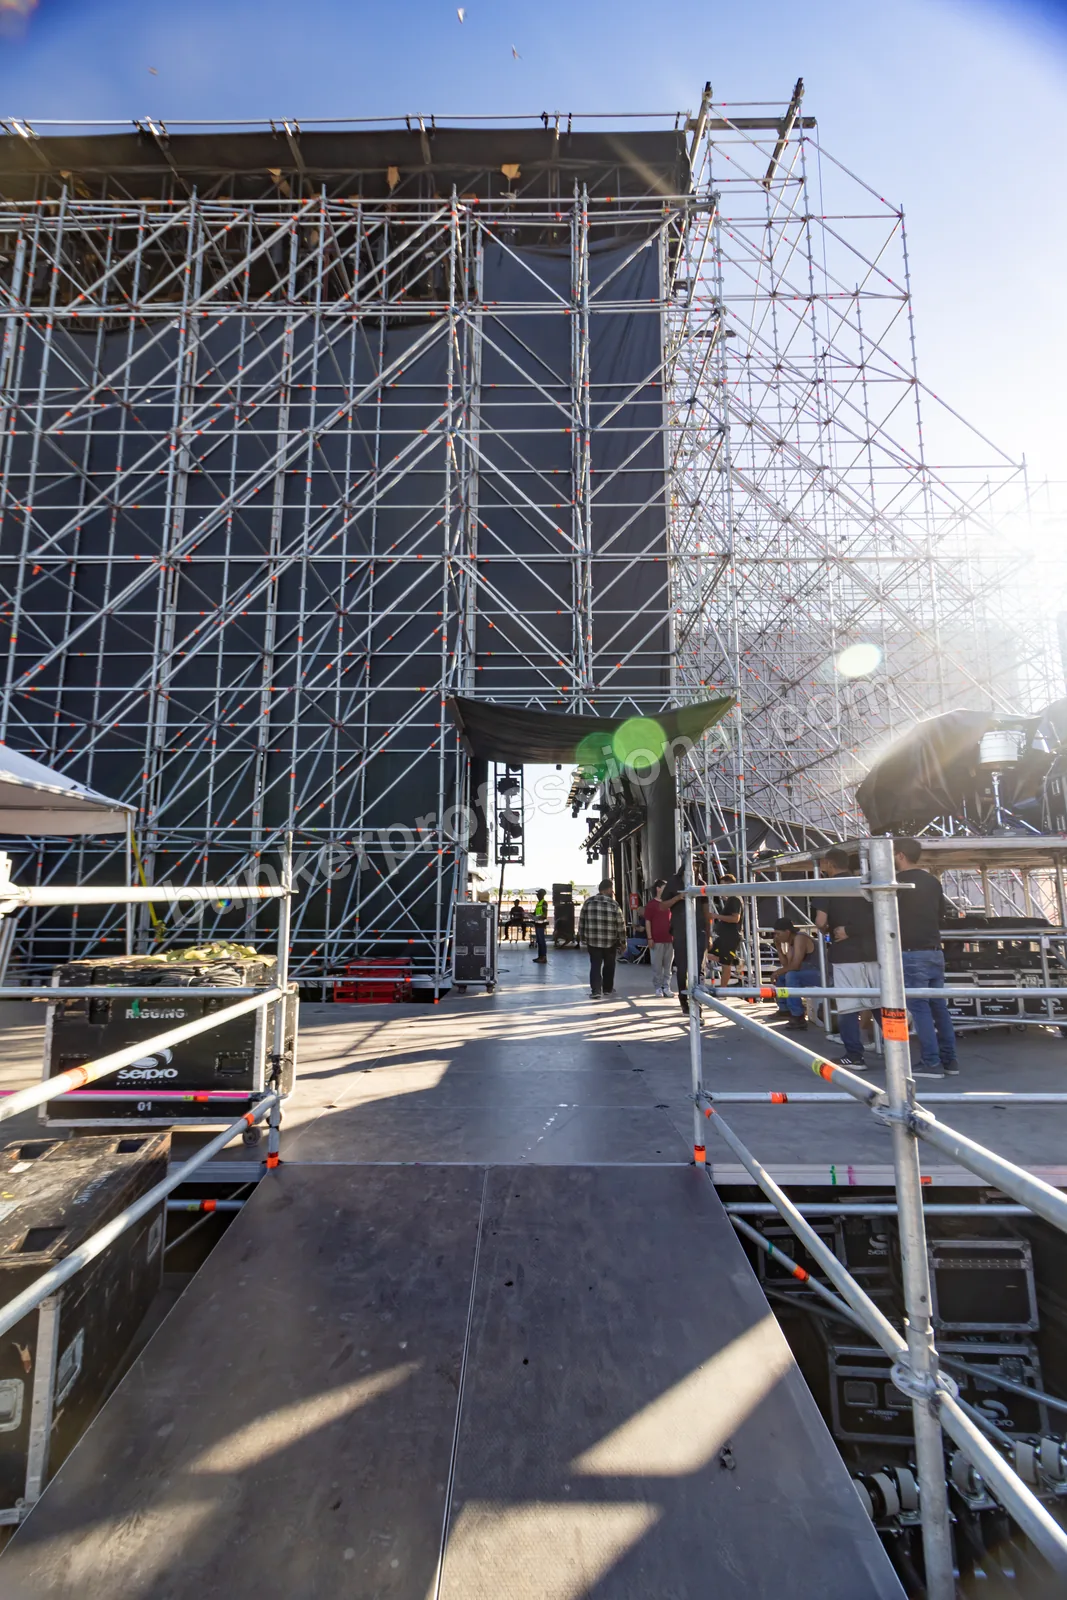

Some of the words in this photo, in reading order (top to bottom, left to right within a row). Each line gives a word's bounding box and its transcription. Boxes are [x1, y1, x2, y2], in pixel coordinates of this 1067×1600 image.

[125, 1008, 185, 1019] RGGING
[117, 1068, 179, 1080] serpro
[137, 1101, 152, 1111] 01
